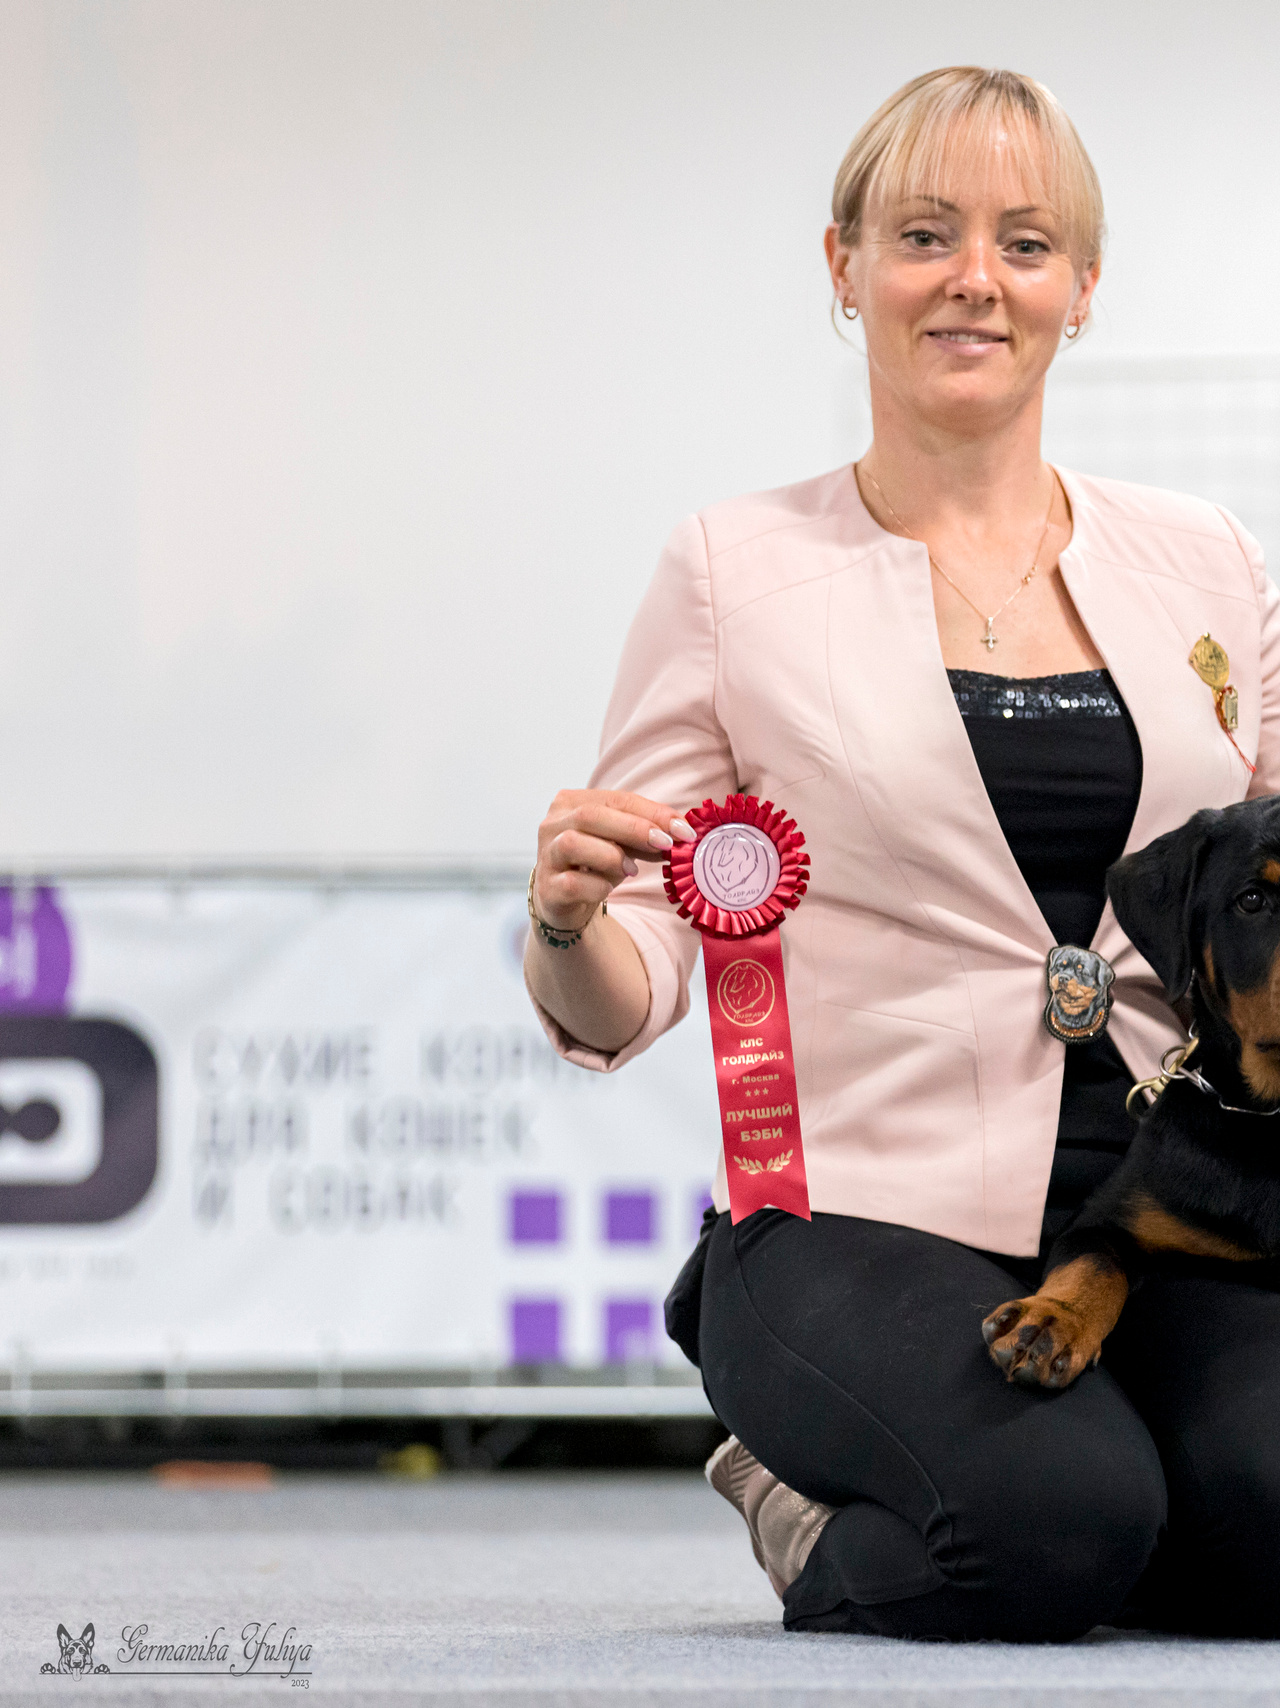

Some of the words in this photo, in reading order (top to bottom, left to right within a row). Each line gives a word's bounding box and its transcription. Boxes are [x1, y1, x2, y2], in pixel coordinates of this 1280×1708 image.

[740, 1037, 764, 1049] КЛС
[420, 1025, 617, 1092] КОРМ
[722, 1049, 785, 1066] ГОЛДРАЙЗ
[742, 1073, 780, 1084] Москва
[725, 1103, 793, 1123] ЛУЧШИЙ
[740, 1127, 783, 1142] БЭБИ
